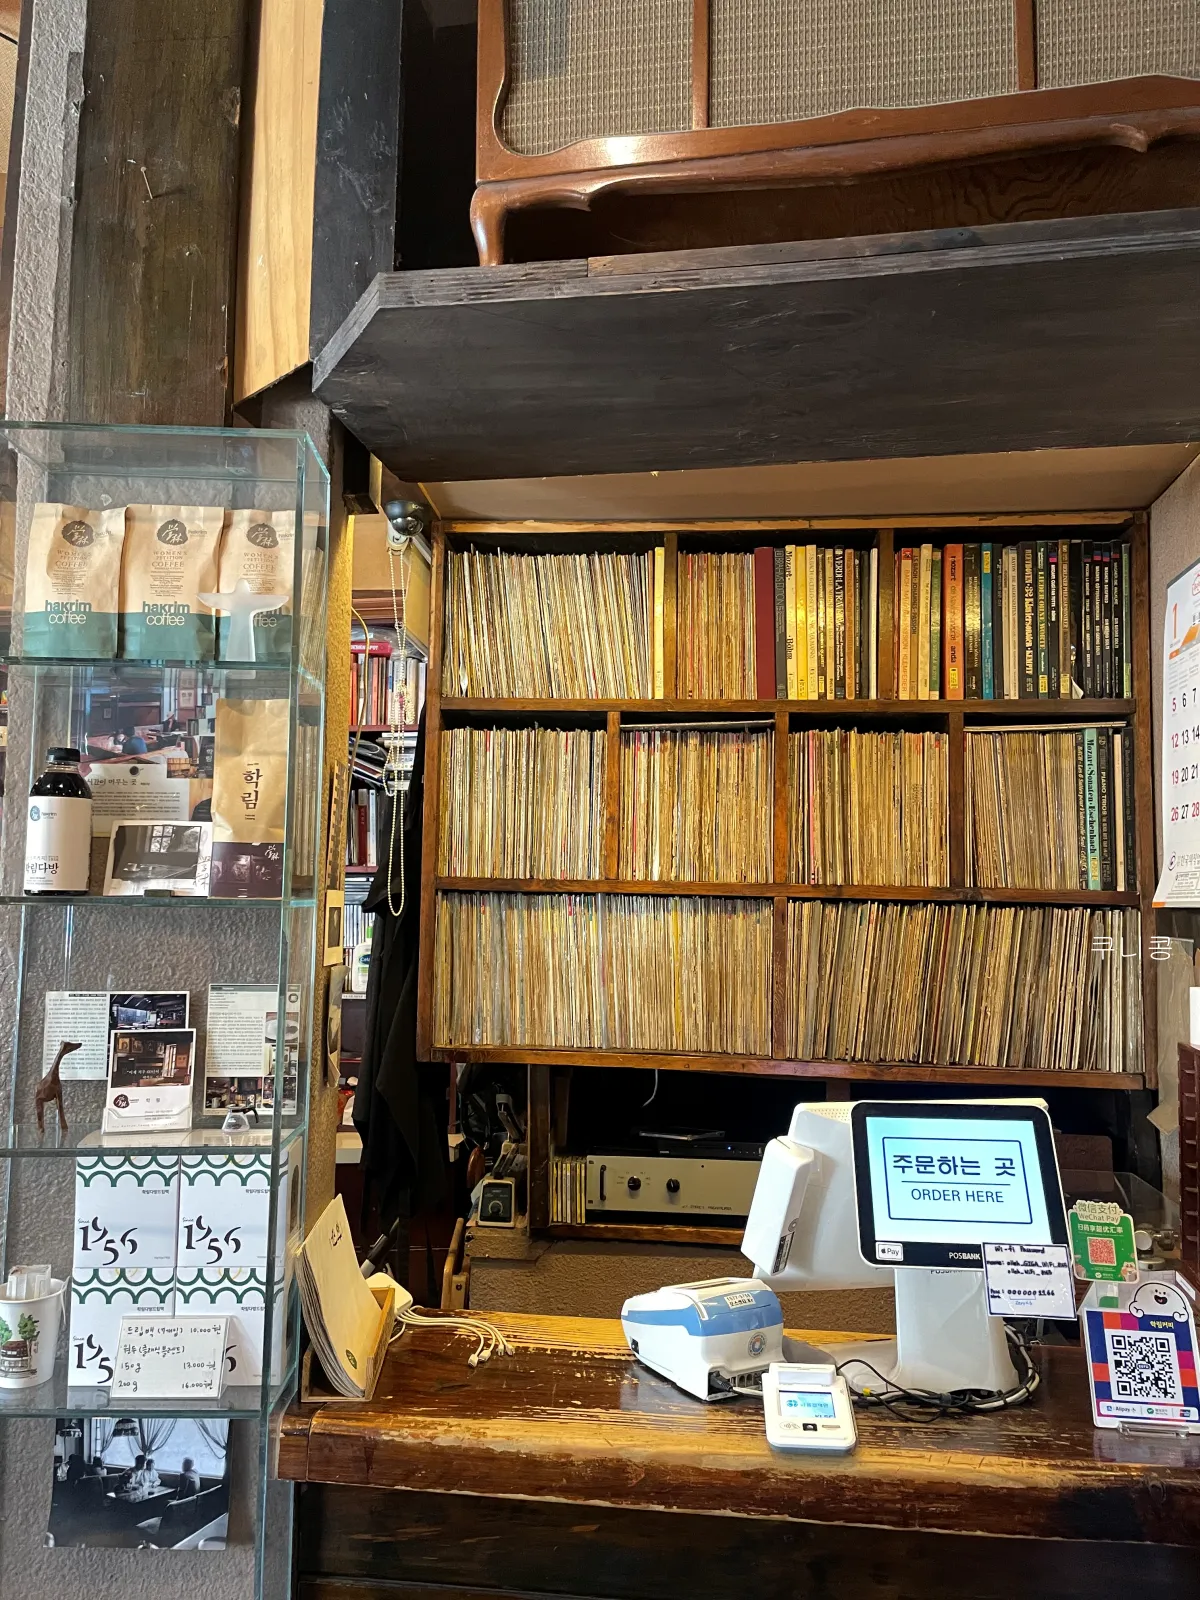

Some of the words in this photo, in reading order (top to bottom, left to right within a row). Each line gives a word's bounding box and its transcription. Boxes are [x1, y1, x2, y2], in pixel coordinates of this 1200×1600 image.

[45, 600, 92, 612] hakrim
[142, 601, 190, 613] hakrim
[48, 612, 87, 624] coffee
[146, 612, 185, 626] coffee
[1172, 603, 1178, 640] 1
[1172, 697, 1177, 711] 5
[1182, 693, 1187, 707] 6
[1192, 688, 1197, 703] 7
[1171, 733, 1179, 748] 12
[1182, 729, 1189, 744] 13
[1191, 725, 1200, 741] 14
[1087, 738, 1095, 767] Mozart
[1172, 770, 1179, 785] 19
[1181, 767, 1189, 782] 20
[1191, 764, 1199, 780] 21
[241, 768, 263, 810] 학림
[1087, 769, 1096, 802] Sonaten
[1171, 807, 1179, 821] 26
[1181, 804, 1189, 819] 27
[1191, 802, 1200, 817] 28
[1088, 805, 1097, 854] Eschenbach
[893, 1155, 981, 1176] 주문하는
[995, 1158, 1016, 1177] 곳
[911, 1188, 961, 1202] ORDER
[965, 1190, 1005, 1203] HERE
[1078, 1202, 1119, 1215] 微信支付
[1079, 1213, 1105, 1222] WeChat
[79, 1216, 138, 1266] 1956
[184, 1215, 242, 1265] 1956
[886, 1248, 900, 1257] Pay
[949, 1252, 981, 1261] POSBANK
